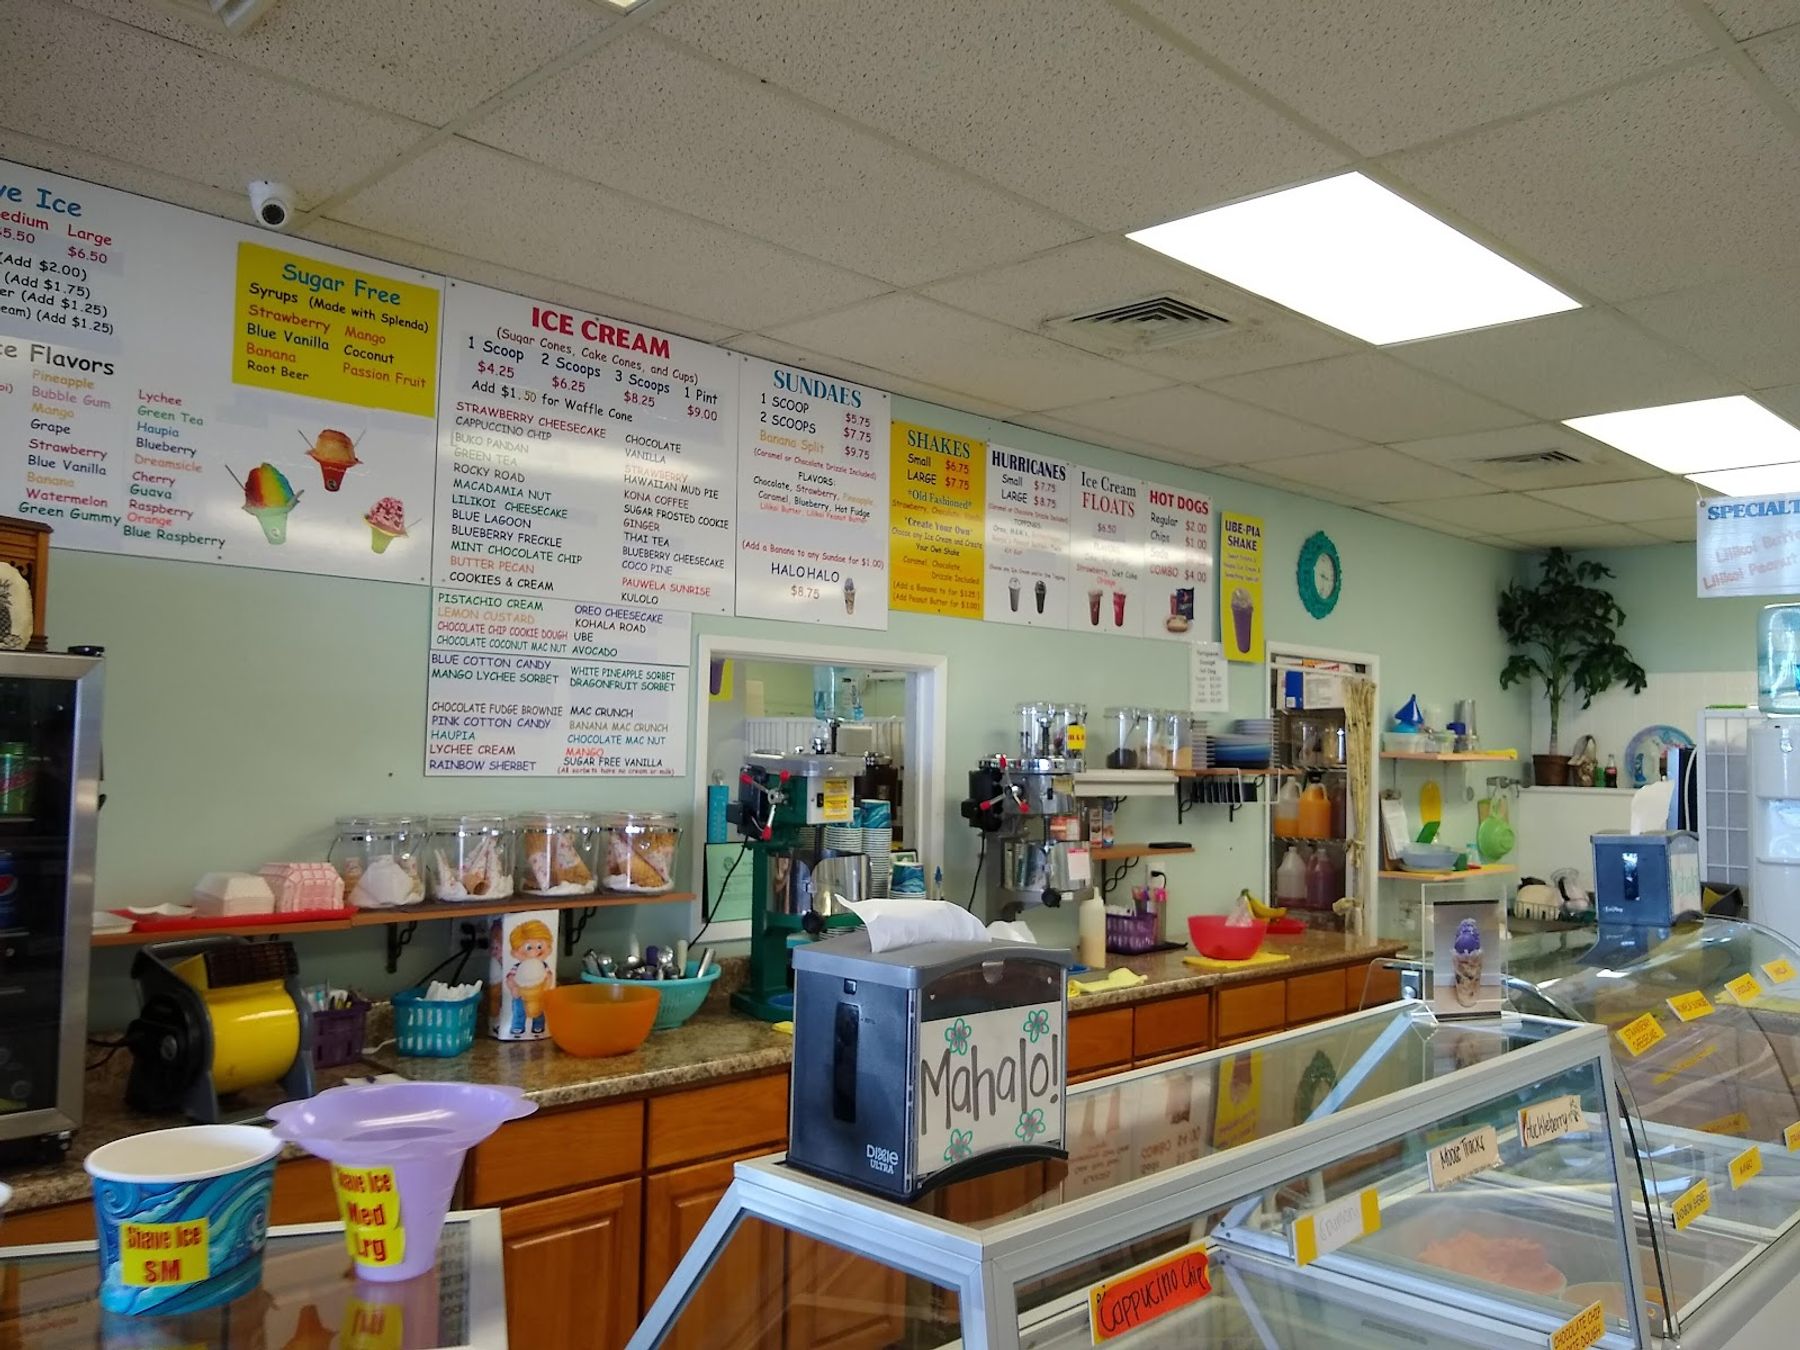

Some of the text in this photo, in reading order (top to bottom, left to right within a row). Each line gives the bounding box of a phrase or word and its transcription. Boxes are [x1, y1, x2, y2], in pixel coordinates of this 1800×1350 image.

[36, 188, 83, 217] Ice
[68, 224, 113, 247] Large
[68, 246, 108, 264] $6.50
[39, 260, 87, 281] $2.00)
[5, 272, 91, 299] (Add $1.75)
[282, 263, 400, 305] Sugar Free
[21, 290, 108, 318] (Add $1.25)
[249, 282, 429, 334] Syrups (Made with Splenda)
[37, 309, 114, 336] (Add $1.25)
[248, 305, 386, 346] Strawberry Mango
[531, 307, 671, 359] ICE CREAM
[247, 323, 395, 364] Blue Vanilla Coconut
[30, 344, 114, 376] Flavors
[246, 342, 426, 388] Banana Passion Fruit
[496, 326, 699, 386] (Sugar Cones, Cake Cones, and Cups)
[247, 360, 309, 381] Root Beer
[468, 336, 718, 405] 1 Scoop 2 Scoops 3 Scoops 1 Pint
[138, 390, 182, 406] Lychee
[477, 360, 718, 422] $4.25 $6.25 $8.25 $9.00
[773, 369, 862, 409] SUNDAES
[472, 380, 496, 394] Add
[542, 393, 560, 406] for
[564, 398, 604, 417] Waffle
[608, 407, 633, 422] Cone
[761, 393, 871, 428] 1 SCOOP $5.75
[30, 419, 71, 435] Grape
[137, 407, 204, 426] Green Tea
[456, 401, 606, 439] STRAWBERRY CHEESECAKE
[137, 422, 179, 438] Haupia
[760, 412, 872, 443] 2 SCOOPS $7.75
[28, 439, 108, 461] Strawberry
[136, 438, 197, 458] Blueberry
[625, 434, 681, 454] CHOCOLATE
[844, 446, 869, 460] $9.75
[907, 429, 970, 459] SHAKES
[28, 455, 107, 476] Blue Vanilla
[453, 463, 525, 483] ROCKY ROAD
[907, 454, 969, 475] Small $6.75
[992, 450, 1066, 481] HURRICANES
[132, 471, 176, 488] Cherry
[798, 471, 837, 487] FLAVORS:
[907, 470, 970, 491] LARGE $7.75
[1002, 474, 1056, 493] Small $7.75
[1081, 471, 1137, 498] Ice Cream
[26, 488, 108, 507] Watermelon
[130, 484, 172, 499] Guava
[453, 479, 552, 502] MACADAMIA NUT
[624, 489, 689, 509] KONA COFFEE
[1001, 489, 1056, 509] LARGE $8.75
[129, 499, 193, 520] Raspberry
[452, 494, 568, 519] LILIKOI CHEESECAKE
[1082, 492, 1136, 518] FLOATS
[1149, 490, 1209, 515] HOT DOGS
[19, 502, 122, 529] Green Gummy
[452, 509, 531, 529] BLUE LAGOON
[1150, 512, 1207, 534] Regular $2.00
[123, 525, 225, 549] Blue Raspberry
[451, 524, 563, 548] BLUEBERRY FRECKLE
[1227, 535, 1257, 551] SHAKE
[449, 572, 554, 592] COOKIES & CREAM
[1184, 569, 1207, 582] $4.00
[438, 593, 544, 611] PISTACHIO CREAM
[791, 586, 820, 600] $8.75
[574, 605, 664, 624] OREO CHEESECAKE
[574, 619, 646, 633] KOHALA ROAD
[574, 632, 593, 642] UBE
[431, 654, 551, 670] BLUE COTTON CANDY
[572, 647, 618, 657] AVOCADO
[431, 730, 476, 741] HAUPIA
[429, 745, 516, 755] LYCHEE CREAM
[429, 760, 536, 771] RAINBOW SHERBET
[921, 1034, 1058, 1136] Mahalo!
[871, 1159, 894, 1174] ULTRA
[370, 1173, 390, 1193] Ice
[348, 1200, 385, 1225] Med
[128, 1224, 201, 1250] Shave Ice
[144, 1259, 180, 1283] SM
[1181, 1259, 1206, 1290] Chip
